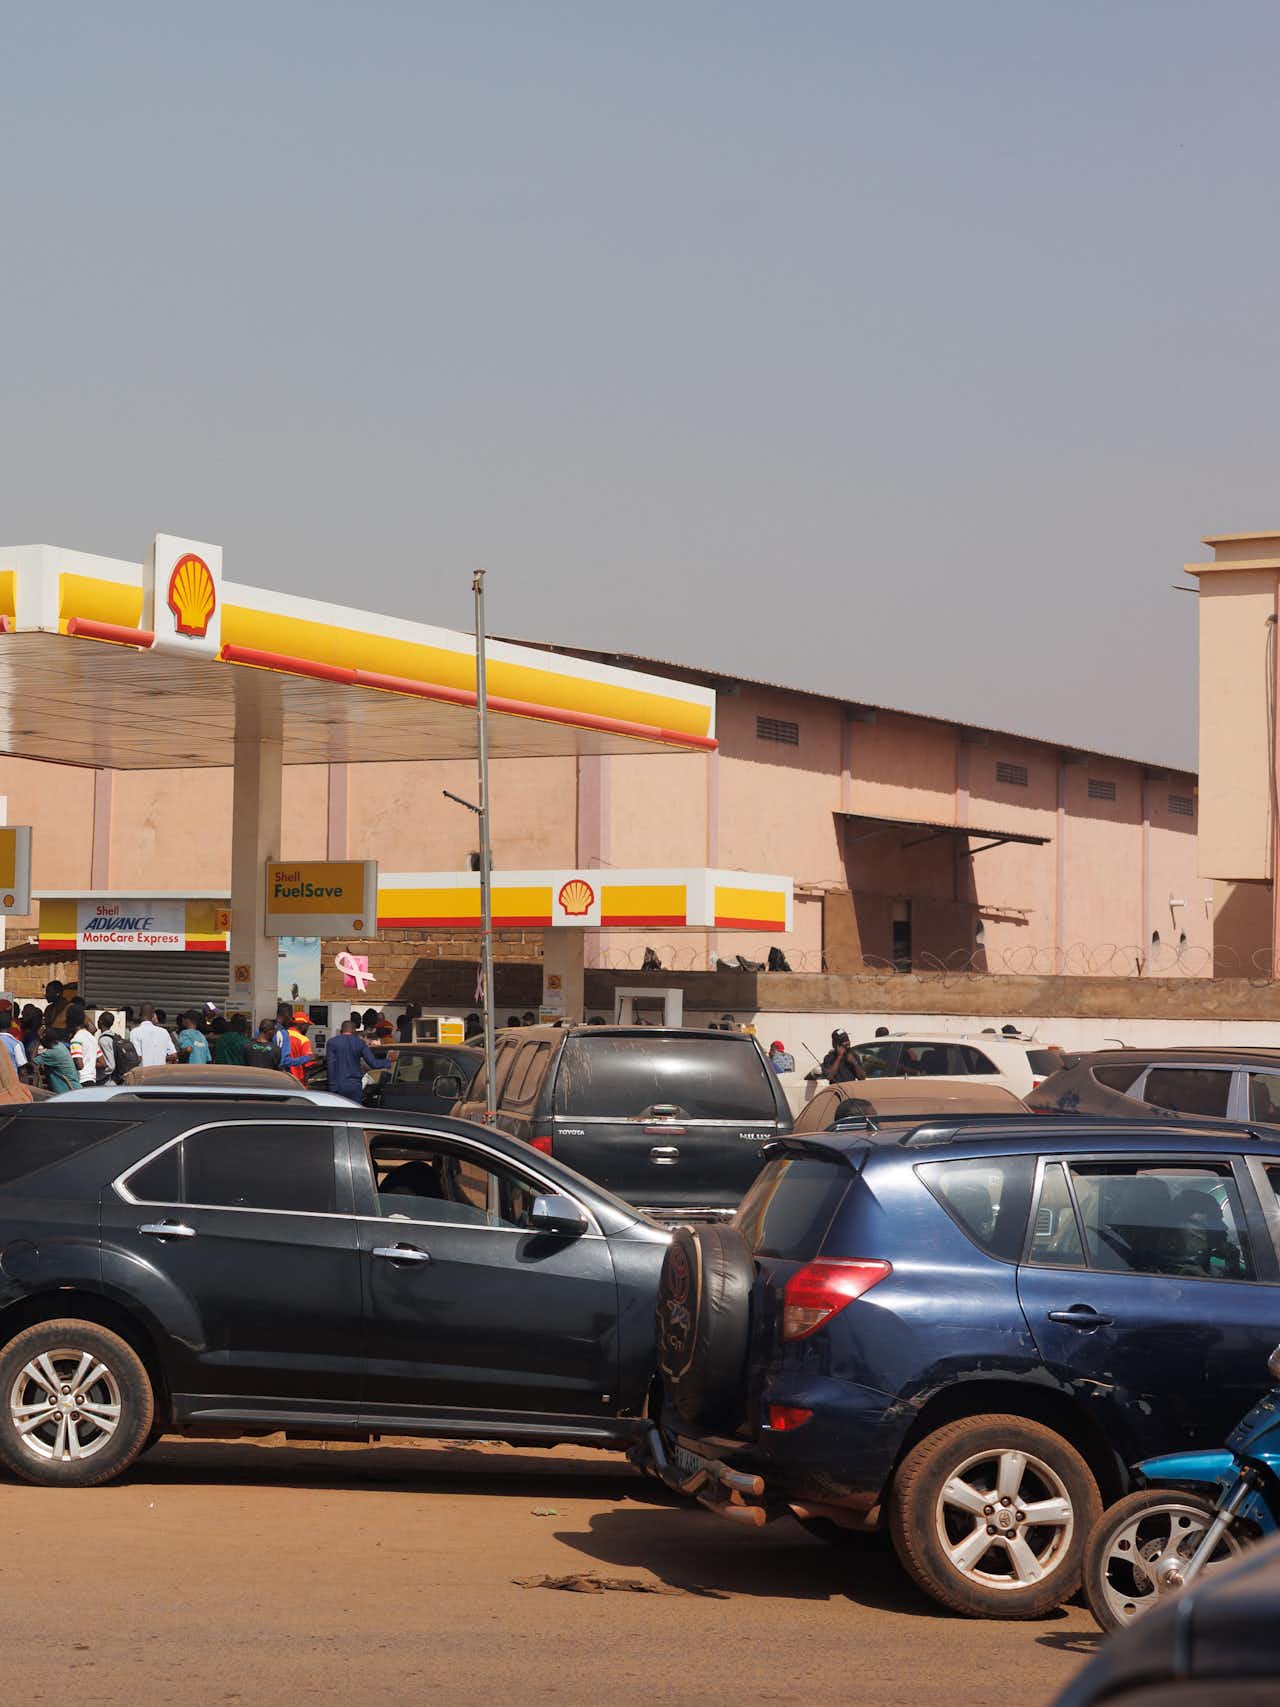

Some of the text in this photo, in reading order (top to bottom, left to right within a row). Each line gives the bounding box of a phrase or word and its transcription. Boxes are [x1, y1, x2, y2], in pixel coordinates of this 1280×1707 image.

[274, 871, 300, 882] Shell
[274, 882, 344, 897] FuelSave
[96, 905, 119, 916] Shell
[85, 917, 154, 930] ADVANCE
[221, 913, 228, 926] 3
[82, 932, 179, 946] MotoCare Express
